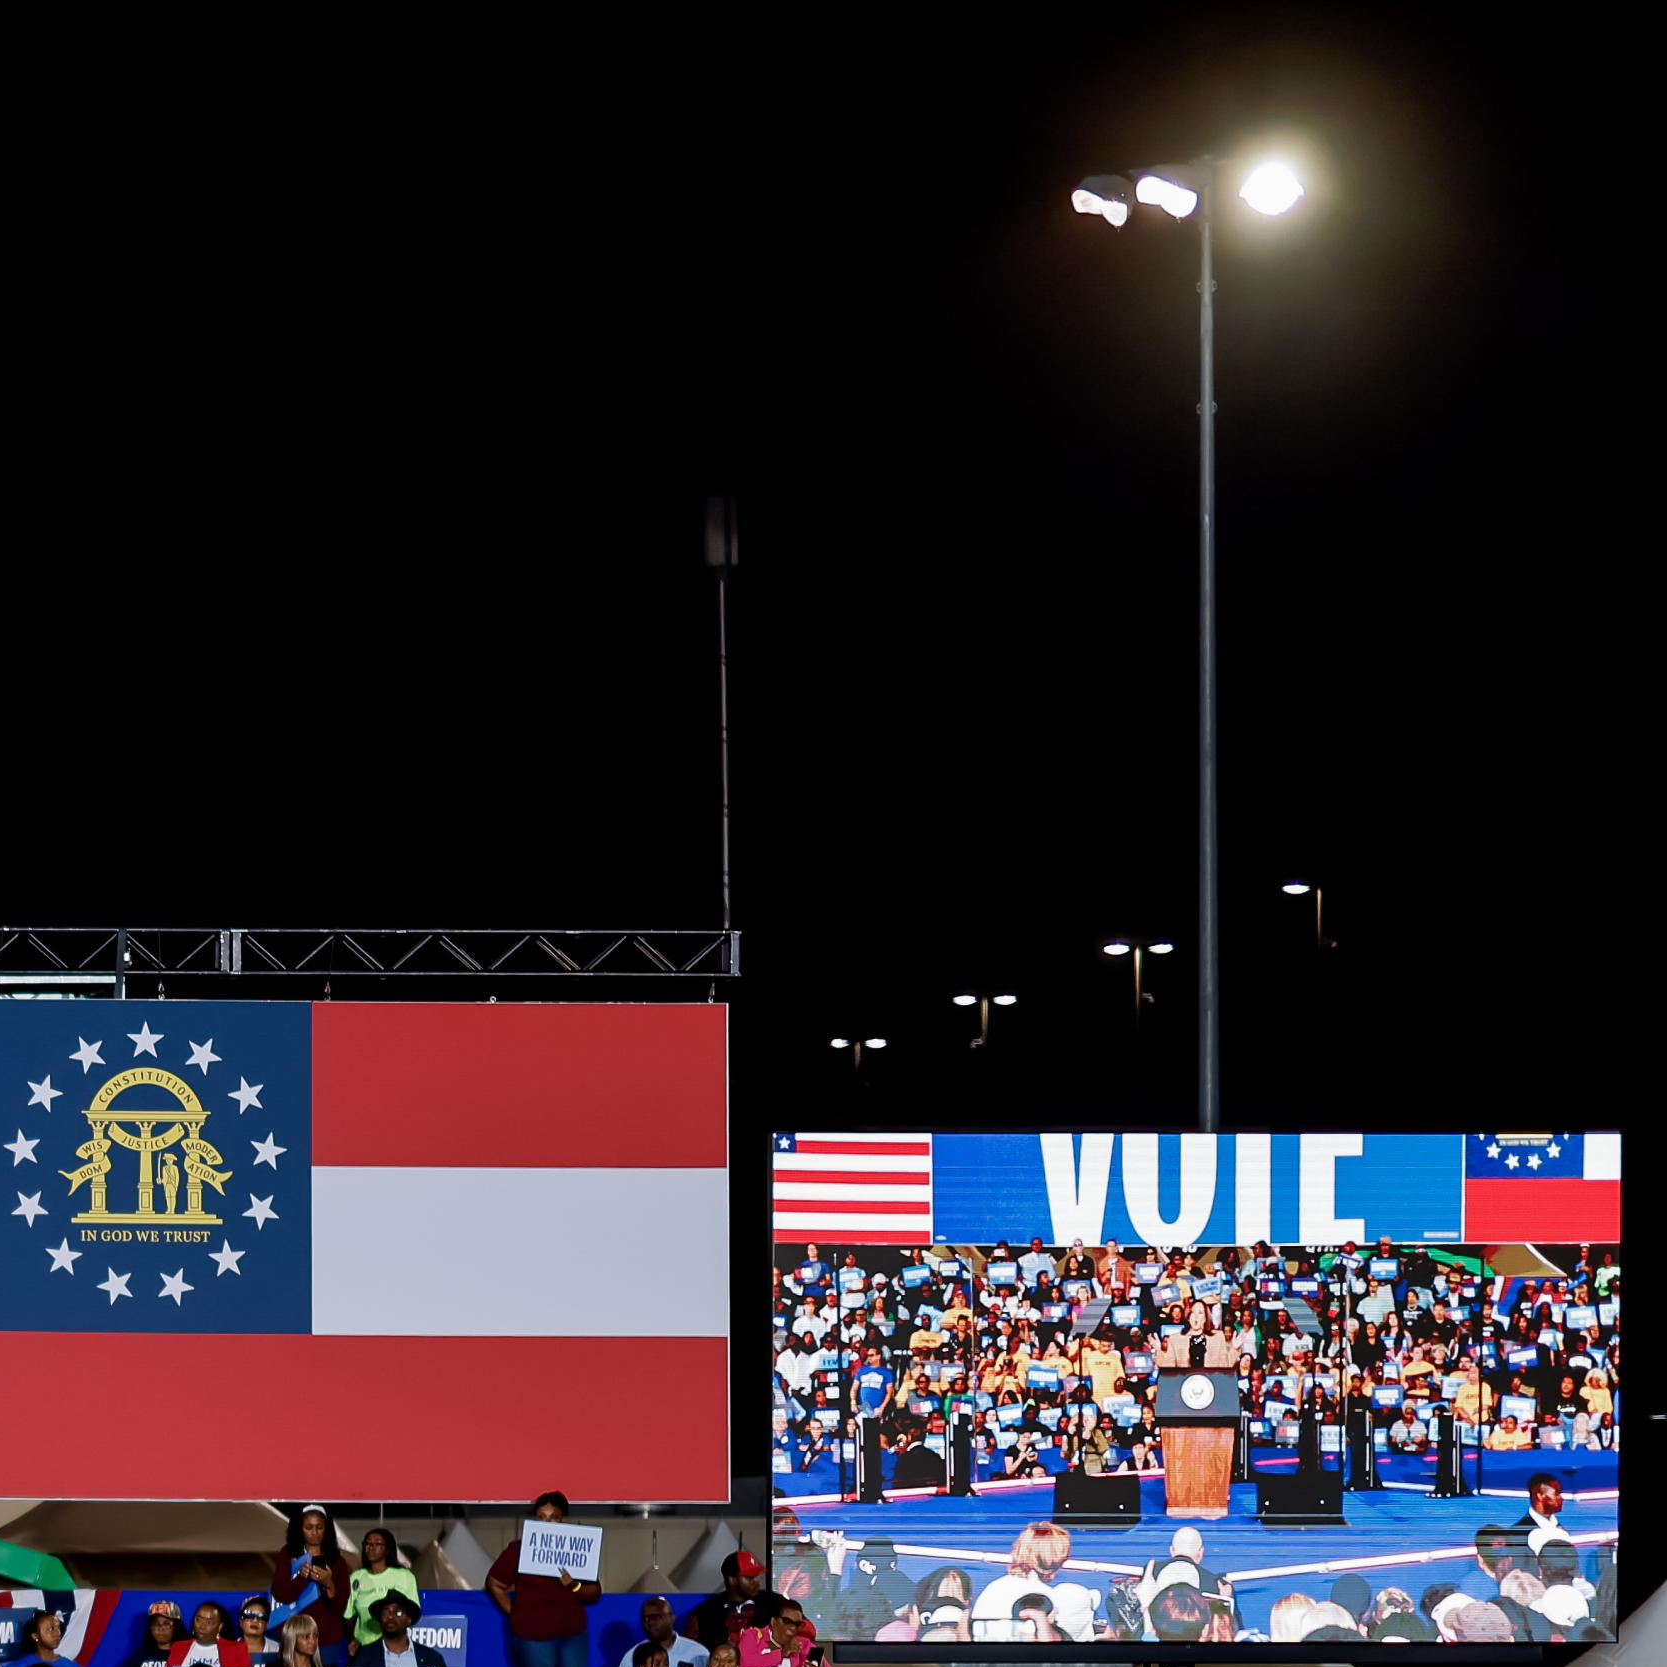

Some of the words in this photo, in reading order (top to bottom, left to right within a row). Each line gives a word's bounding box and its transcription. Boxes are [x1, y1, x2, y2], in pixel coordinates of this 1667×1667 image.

[98, 1070, 195, 1105] CONSTITUTION
[81, 1140, 104, 1154] WIS
[121, 1134, 169, 1150] JUSTICE
[185, 1141, 218, 1164] MODER
[79, 1164, 103, 1180] DOM
[187, 1164, 218, 1182] ATION
[80, 1230, 98, 1242] IN
[101, 1230, 133, 1242] GOD
[136, 1230, 160, 1243] WE
[165, 1231, 211, 1243] TRUST
[529, 1532, 536, 1546] A
[540, 1534, 565, 1551] NEW
[568, 1536, 594, 1553] WAY
[531, 1550, 587, 1568] FORWARD
